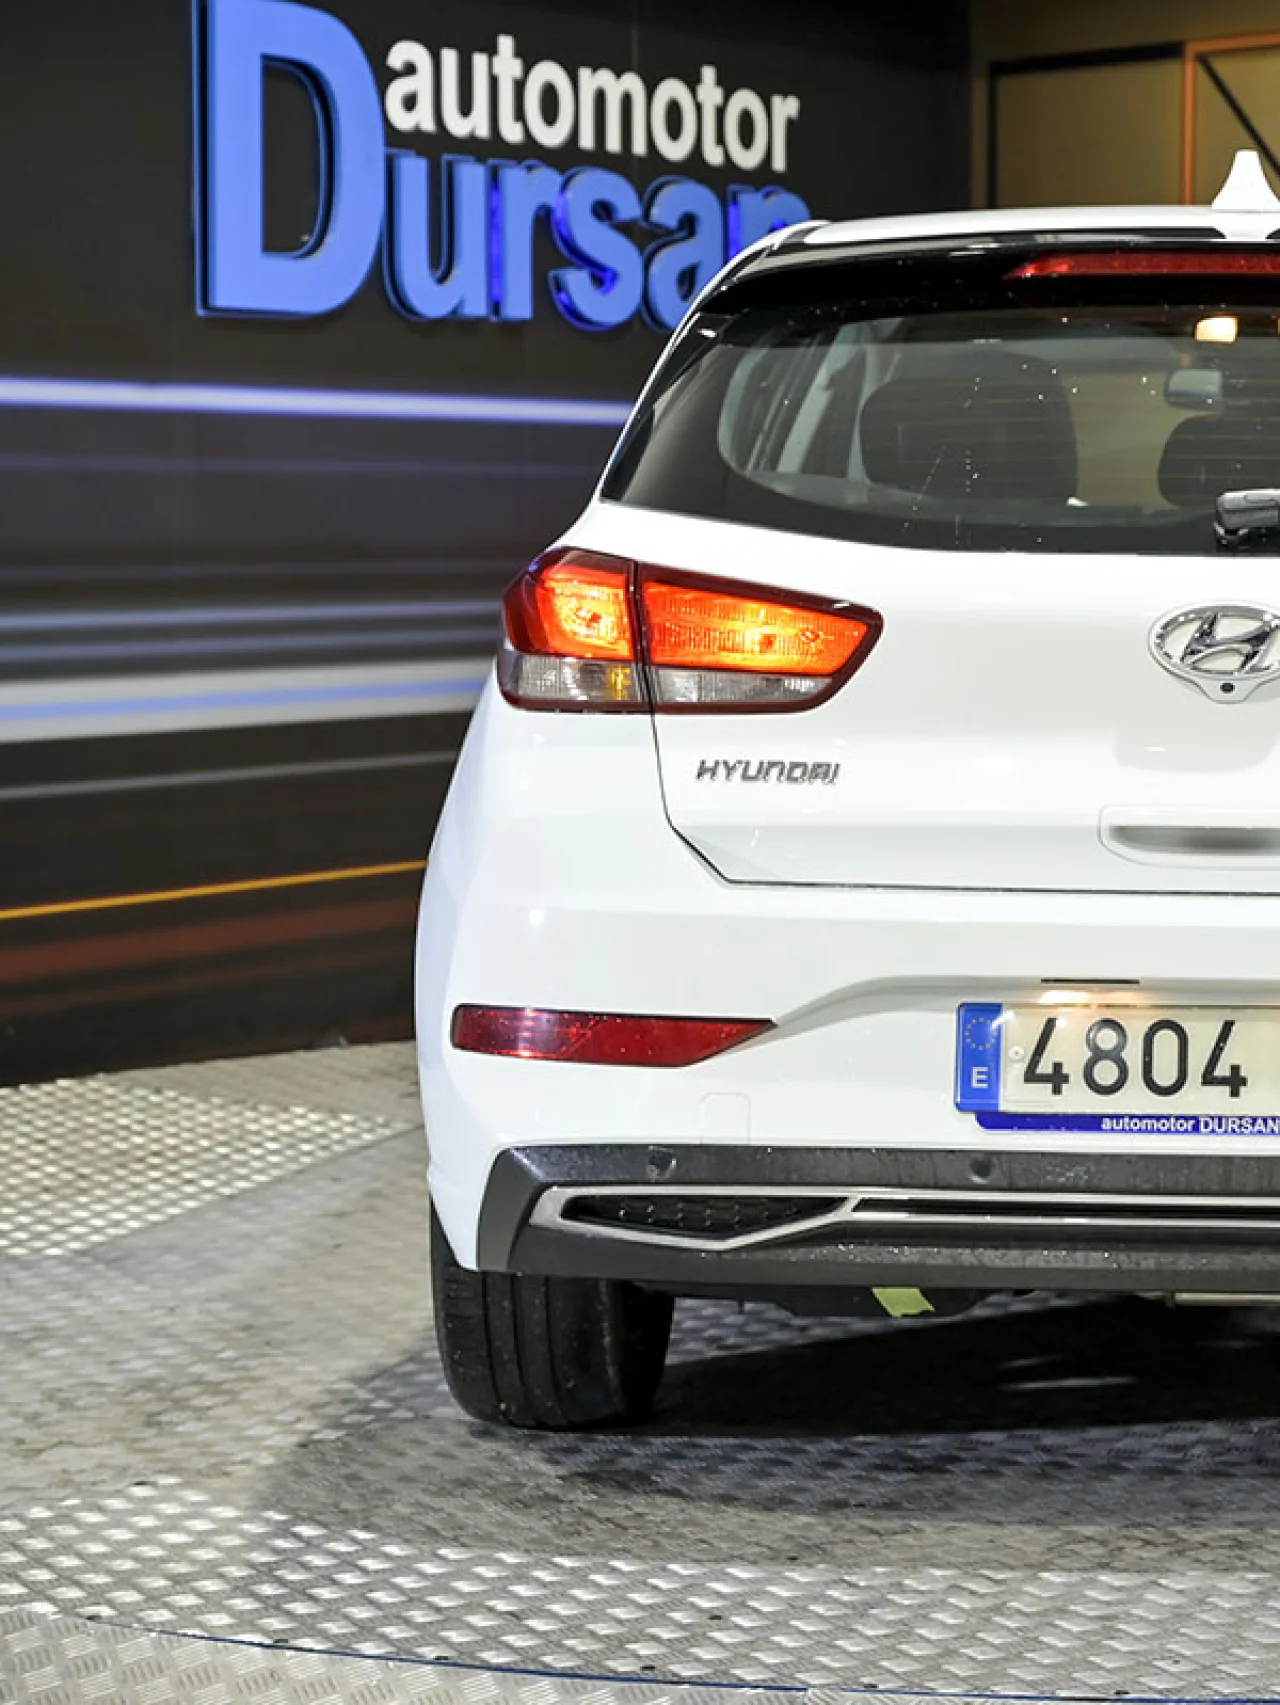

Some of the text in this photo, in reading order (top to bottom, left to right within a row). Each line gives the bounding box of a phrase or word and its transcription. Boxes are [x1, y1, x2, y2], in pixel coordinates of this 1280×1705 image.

[385, 35, 799, 172] automotor
[697, 759, 841, 785] HYUNDAI
[1024, 1017, 1247, 1097] 4804
[971, 1066, 988, 1088] E
[1100, 1116, 1195, 1131] automotor
